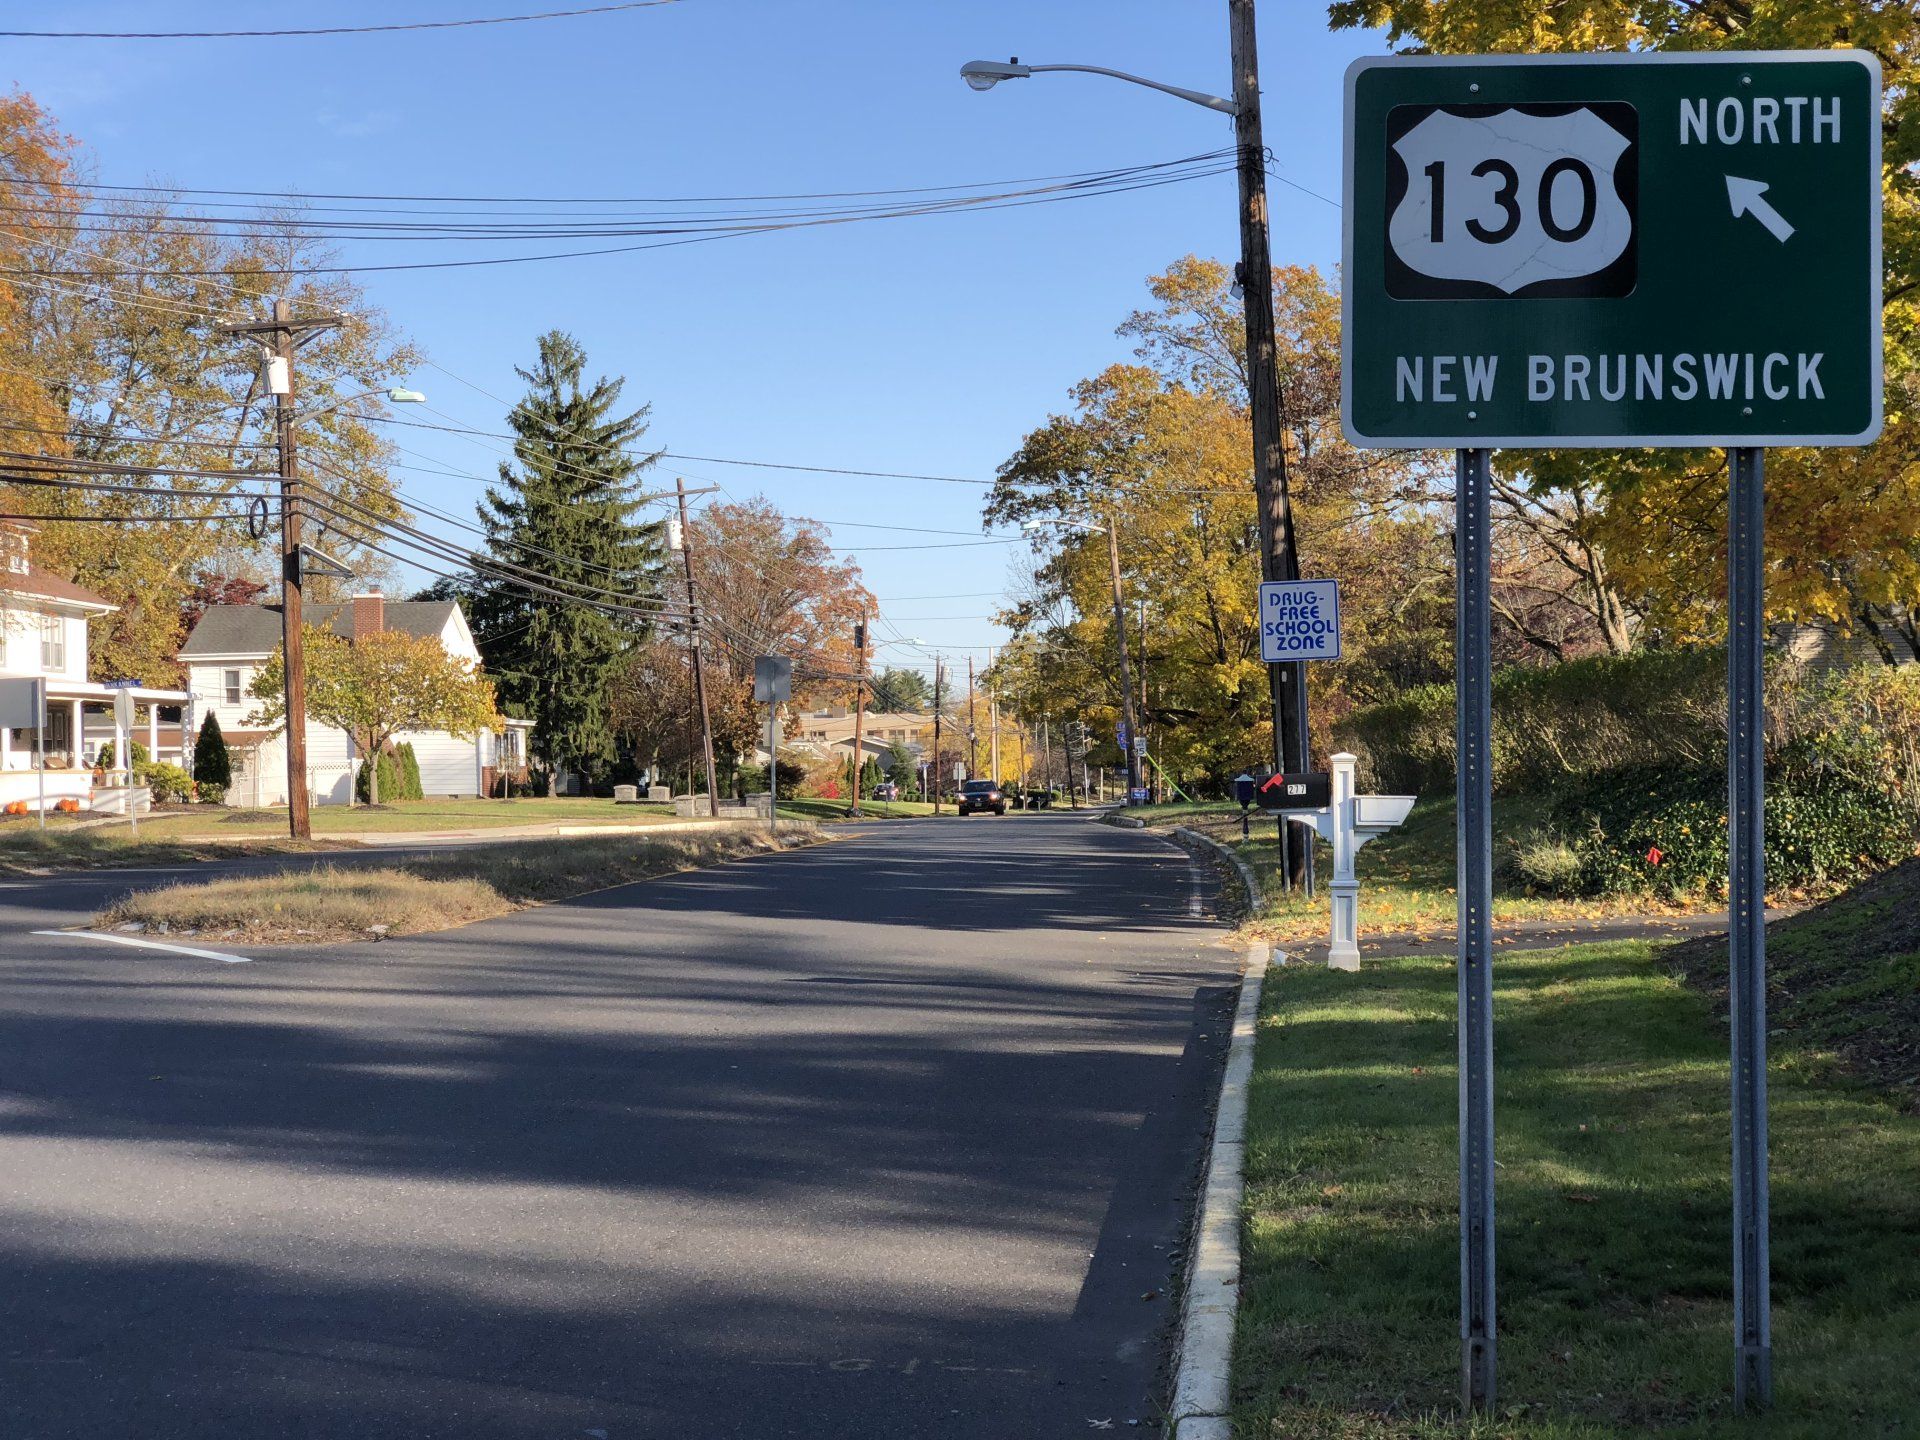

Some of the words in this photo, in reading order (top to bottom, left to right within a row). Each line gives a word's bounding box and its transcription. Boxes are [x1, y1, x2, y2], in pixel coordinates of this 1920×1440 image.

[1679, 96, 1842, 145] NORTH
[1424, 157, 1597, 244] 130
[1395, 355, 1499, 402] NEW
[1527, 352, 1826, 401] BRUNSWICK
[1269, 591, 1325, 606] DRUG-
[1279, 606, 1320, 621] FREE
[1265, 620, 1335, 636] SCHOOL
[1288, 785, 1305, 795] 277
